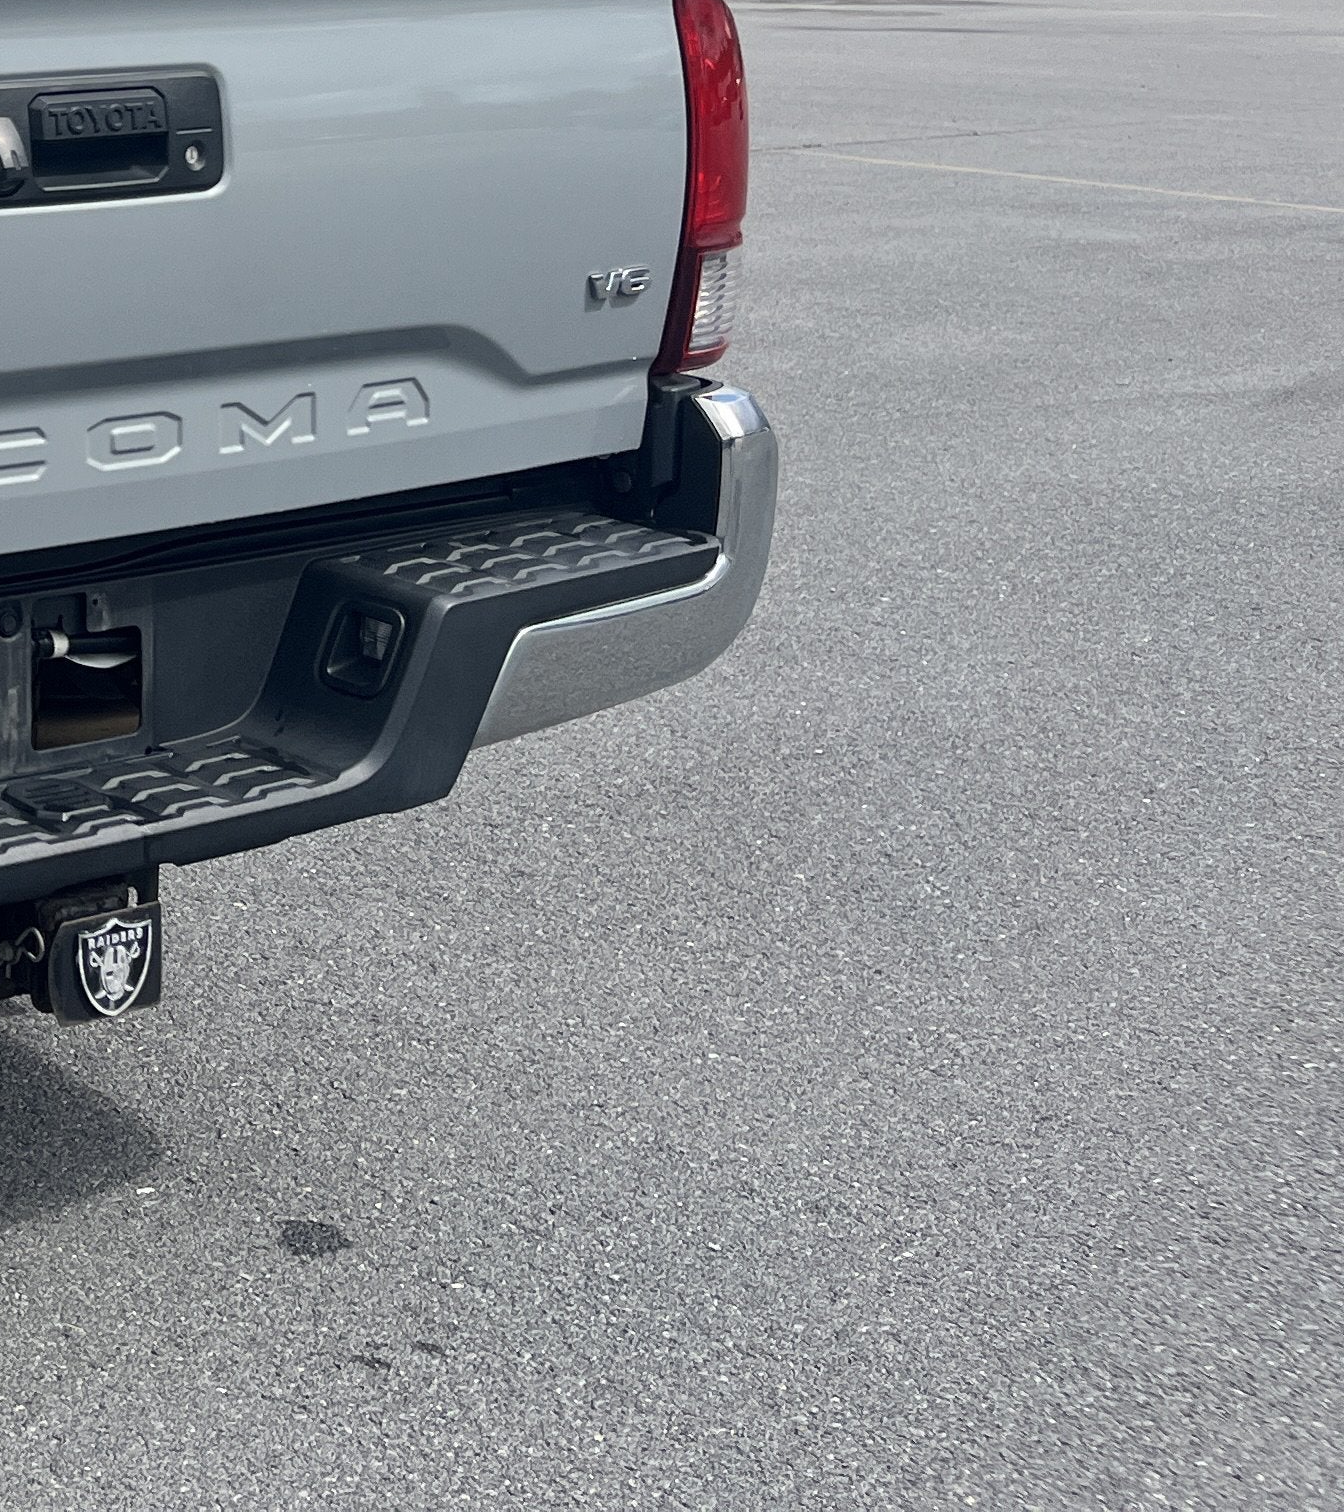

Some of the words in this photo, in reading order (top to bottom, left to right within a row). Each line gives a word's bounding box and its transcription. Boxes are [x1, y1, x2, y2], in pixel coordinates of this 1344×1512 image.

[48, 101, 163, 136] TOYOTA
[585, 265, 651, 301] V6
[87, 927, 144, 950] RAIDERS
